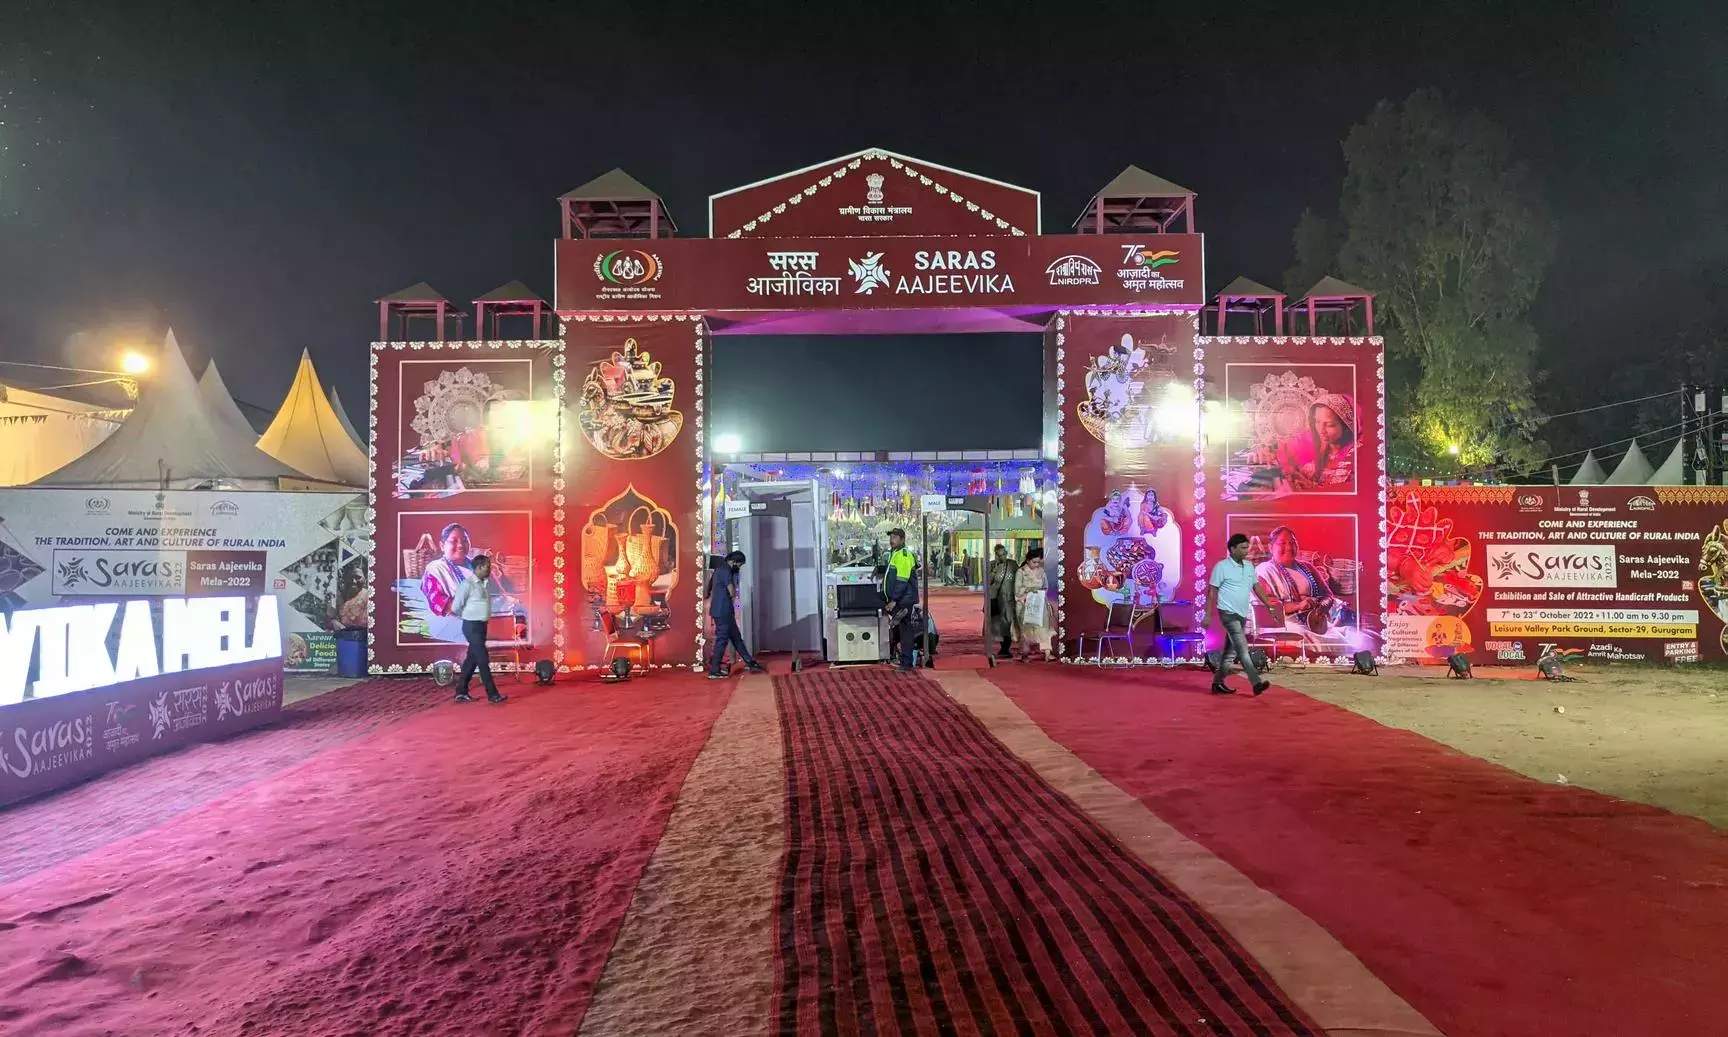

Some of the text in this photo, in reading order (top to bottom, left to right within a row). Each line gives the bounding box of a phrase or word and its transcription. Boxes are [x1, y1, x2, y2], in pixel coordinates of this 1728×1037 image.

[839, 206, 912, 215] ग्रामीण विकास मंत्रालय
[767, 252, 819, 270] सरस
[914, 250, 996, 270] SARAS
[746, 271, 842, 295] आजीविका
[896, 274, 1015, 294] AAJEEVIKA
[1123, 277, 1184, 292] अमृत महोत्सव
[161, 528, 217, 536] EXPERIENCE
[1497, 532, 1546, 540] TRADITION,
[34, 537, 52, 545] THE
[56, 537, 111, 547] TRADITION,
[115, 538, 134, 546] ART
[137, 538, 159, 546] AND
[162, 538, 203, 546] CULTURE
[258, 539, 286, 547] INDIA
[1520, 552, 1603, 580] Saras
[1619, 555, 1690, 566] Saras Aajeevika
[190, 561, 262, 572] Saras Aajeevika
[88, 558, 172, 587] Saras
[174, 562, 183, 587] 2022
[1631, 570, 1679, 578] Mela-2022
[200, 576, 250, 586] Mela-2022
[1494, 592, 1689, 602] Exhibition and Sale of Attractive Handicraft Products
[1389, 621, 1409, 629] Enjoy
[1524, 626, 1549, 634] Valley
[1651, 627, 1692, 635] Gurugram
[163, 595, 282, 672] MELA
[1485, 641, 1513, 650] VOCAL
[1498, 650, 1526, 659] LOCAL
[231, 678, 272, 716] Saras
[8, 718, 84, 778] Saras
[33, 748, 84, 776] AAJEEVIKA
